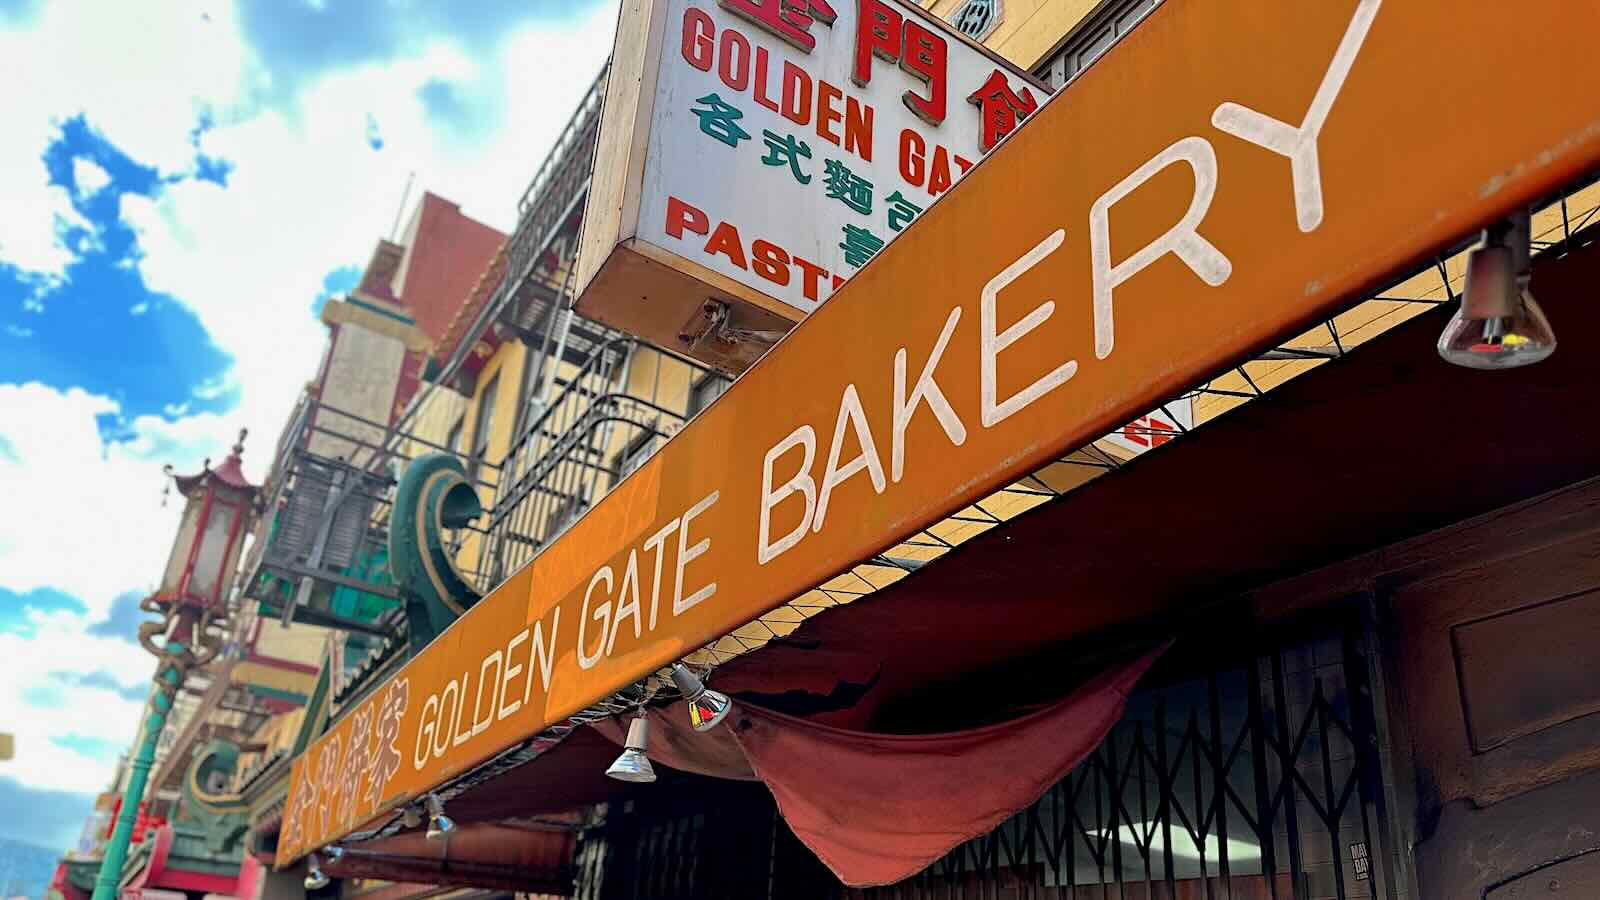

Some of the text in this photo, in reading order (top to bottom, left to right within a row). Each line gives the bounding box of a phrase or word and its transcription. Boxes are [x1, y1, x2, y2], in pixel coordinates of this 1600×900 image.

[681, 7, 873, 162] GOLDEN
[665, 196, 851, 303] PAST
[414, 606, 560, 769] GOLDEN
[577, 490, 720, 671] GATE
[758, 0, 1383, 566] BAKERY
